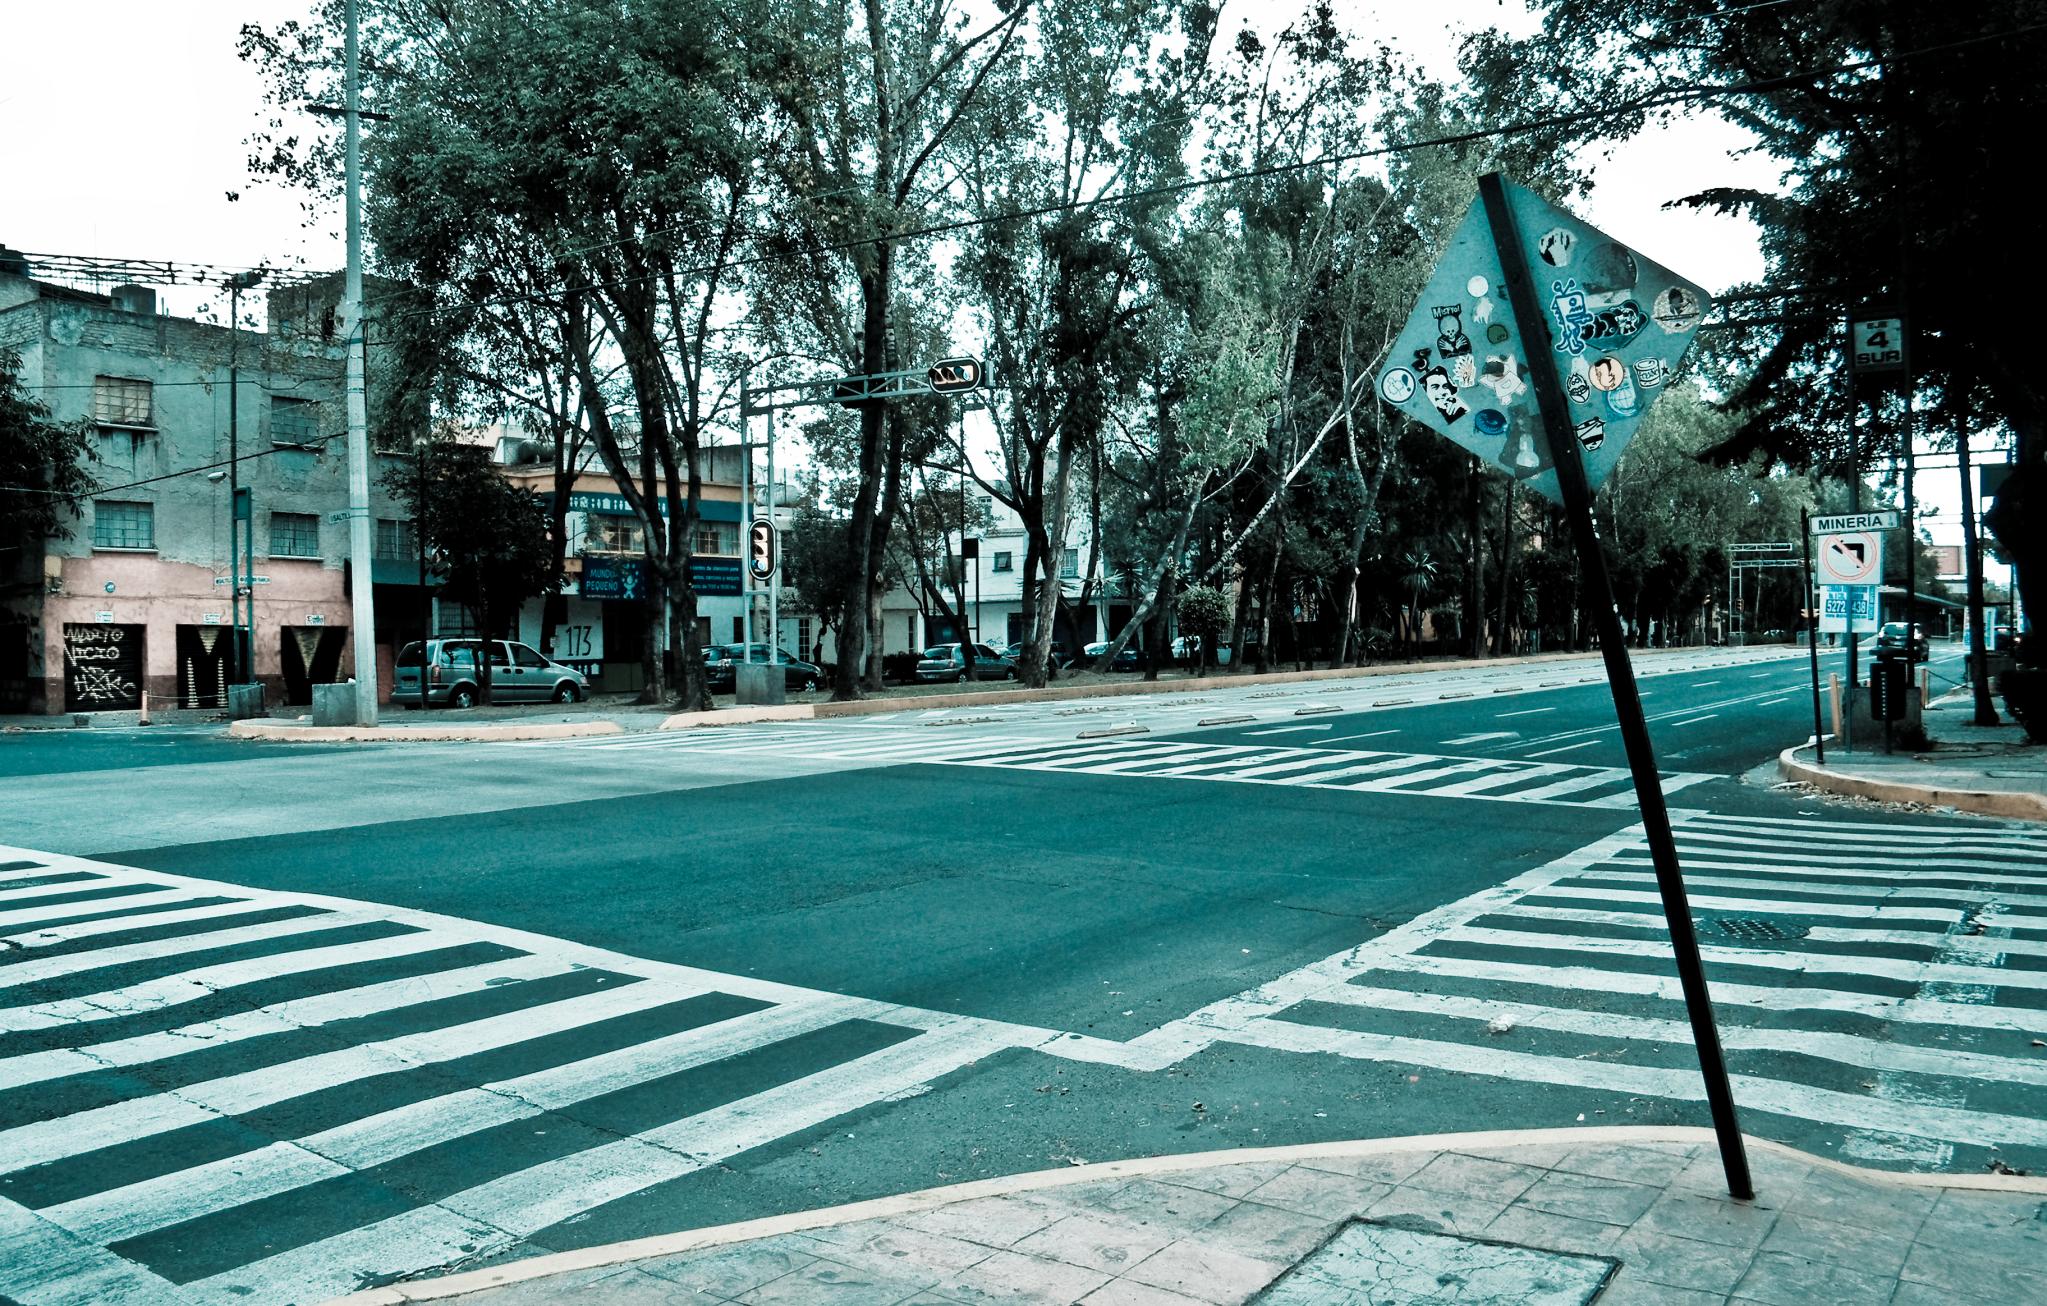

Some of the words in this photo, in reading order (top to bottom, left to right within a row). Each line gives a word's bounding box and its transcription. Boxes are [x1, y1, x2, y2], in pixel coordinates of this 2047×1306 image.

[1867, 321, 1887, 329] EJE
[1867, 332, 1888, 348] 4
[1857, 351, 1899, 364] SUR
[1818, 513, 1882, 530] MINERÍA
[1826, 600, 1846, 612] 5272
[566, 626, 591, 657] 173
